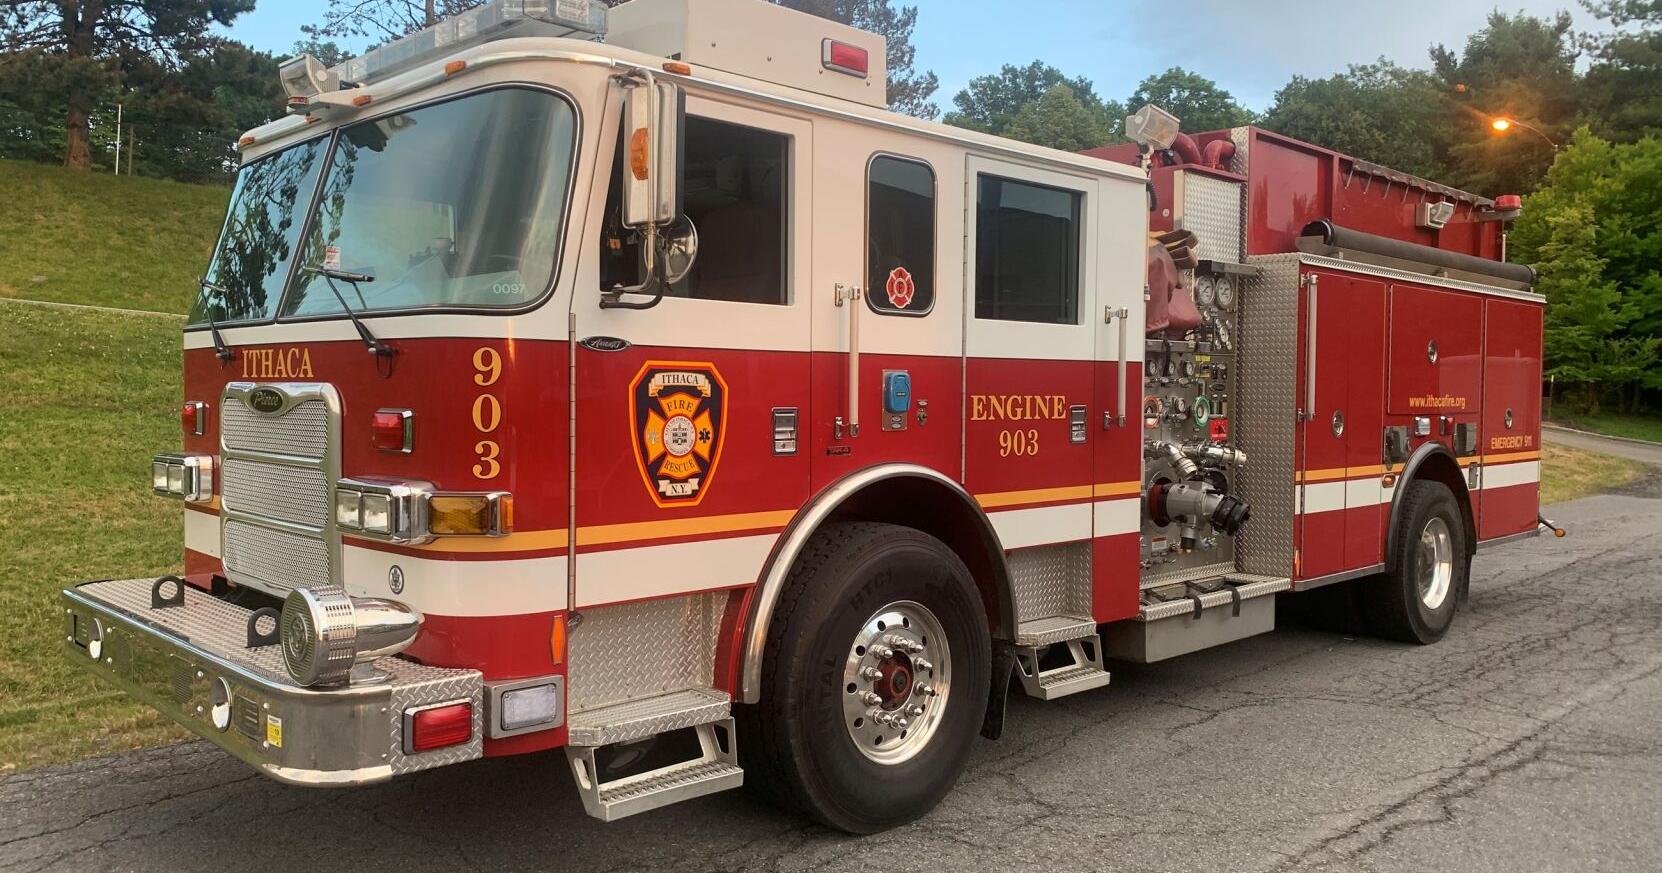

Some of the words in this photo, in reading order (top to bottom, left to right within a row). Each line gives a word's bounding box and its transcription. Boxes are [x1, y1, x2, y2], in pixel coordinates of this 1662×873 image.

[493, 283, 525, 294] 0097
[242, 348, 314, 378] ITHACA
[662, 374, 699, 384] ITHACA
[666, 399, 694, 412] FIRE
[970, 395, 1067, 420] ENGINE
[1409, 394, 1466, 409] www.ithacafire.org
[472, 346, 502, 480] 903
[999, 429, 1039, 457] 903
[1491, 436, 1523, 449] EMERGENCY
[664, 459, 695, 472] RESCUE
[671, 484, 688, 494] N.Y.
